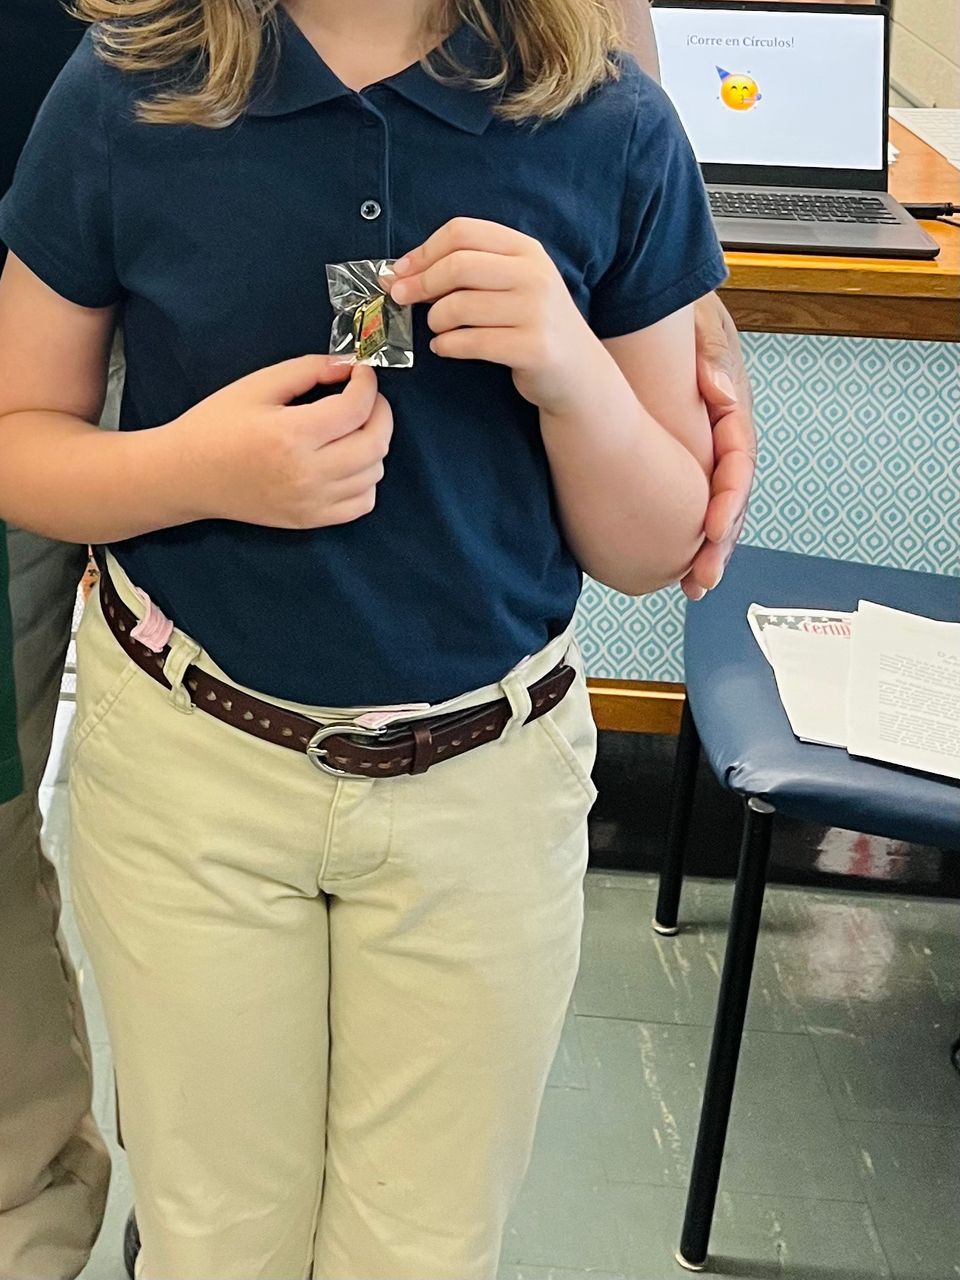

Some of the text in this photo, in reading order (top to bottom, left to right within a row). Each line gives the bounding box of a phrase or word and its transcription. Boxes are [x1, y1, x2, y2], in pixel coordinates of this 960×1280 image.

[686, 34, 795, 48] ¡Corre en Círculos!
